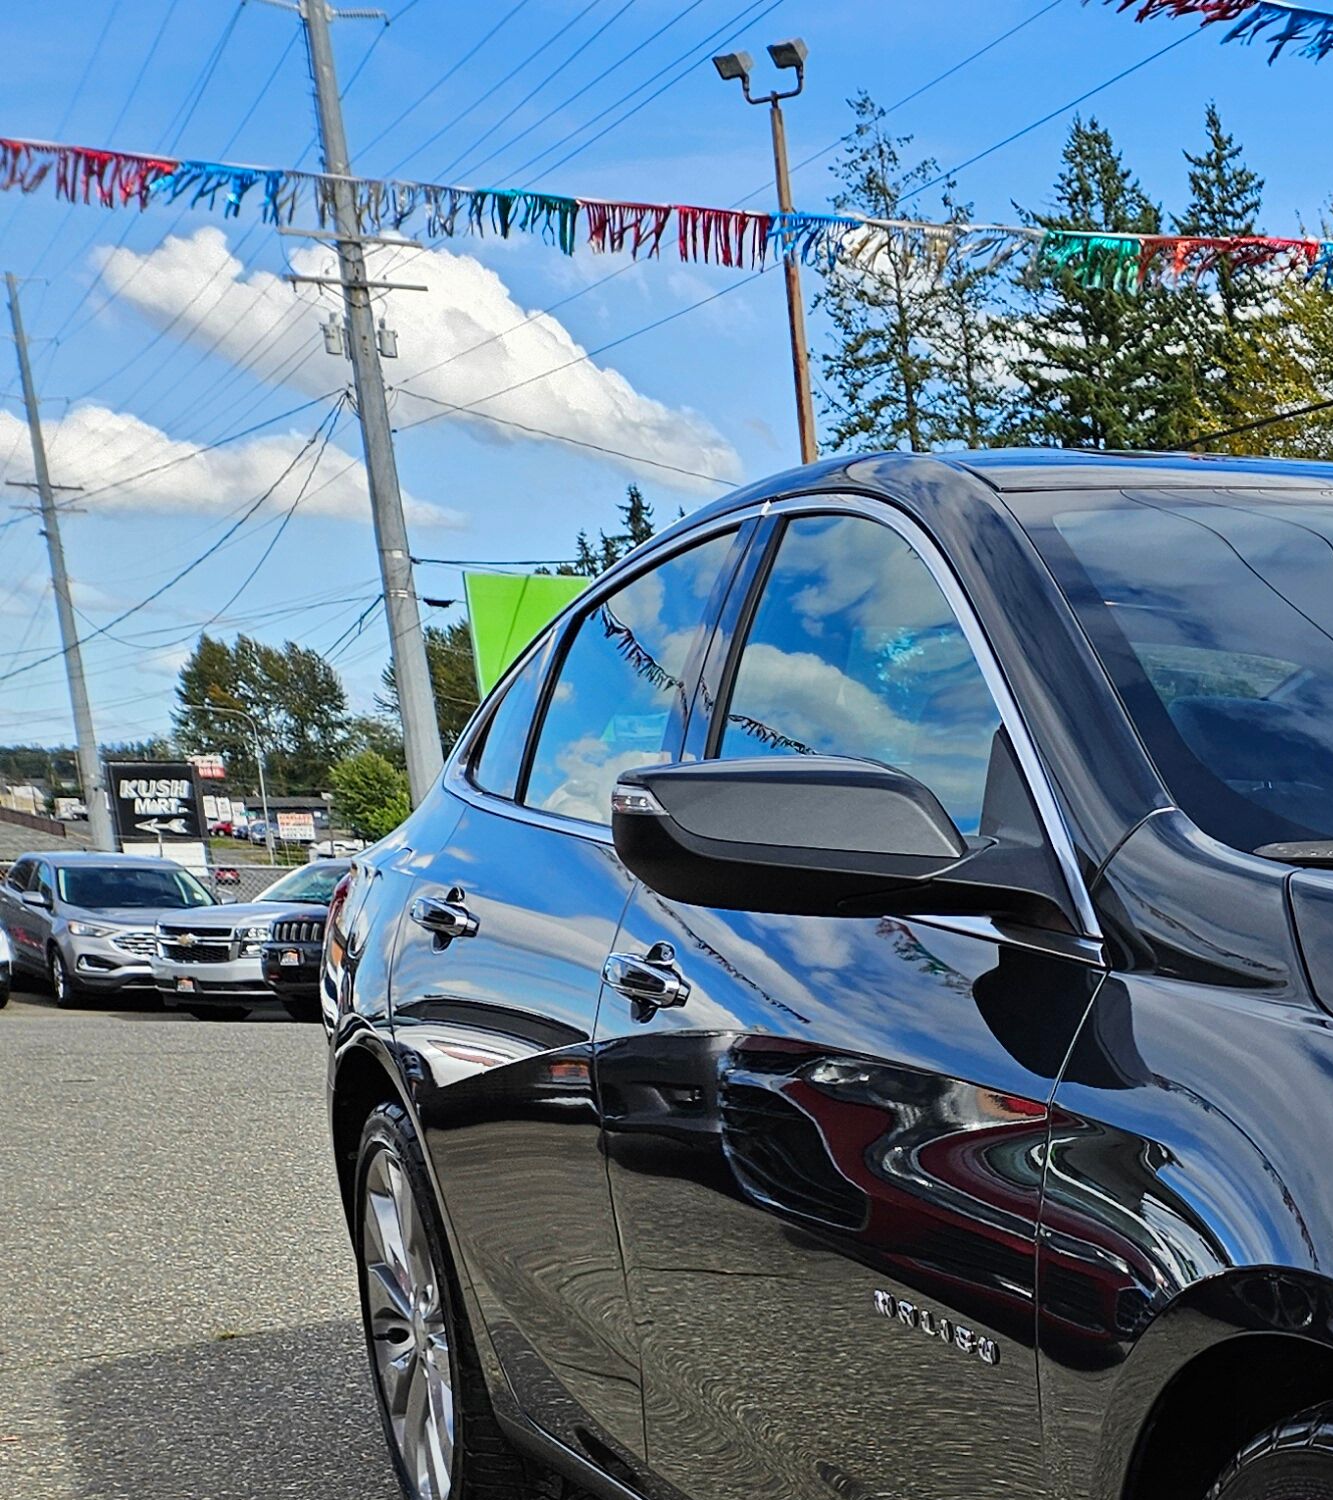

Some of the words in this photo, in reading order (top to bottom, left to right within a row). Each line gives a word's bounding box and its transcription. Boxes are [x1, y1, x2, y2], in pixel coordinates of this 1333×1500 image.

[120, 779, 190, 799] KUSH
[134, 798, 178, 815] MART
[873, 1289, 1000, 1365] MALIBU
